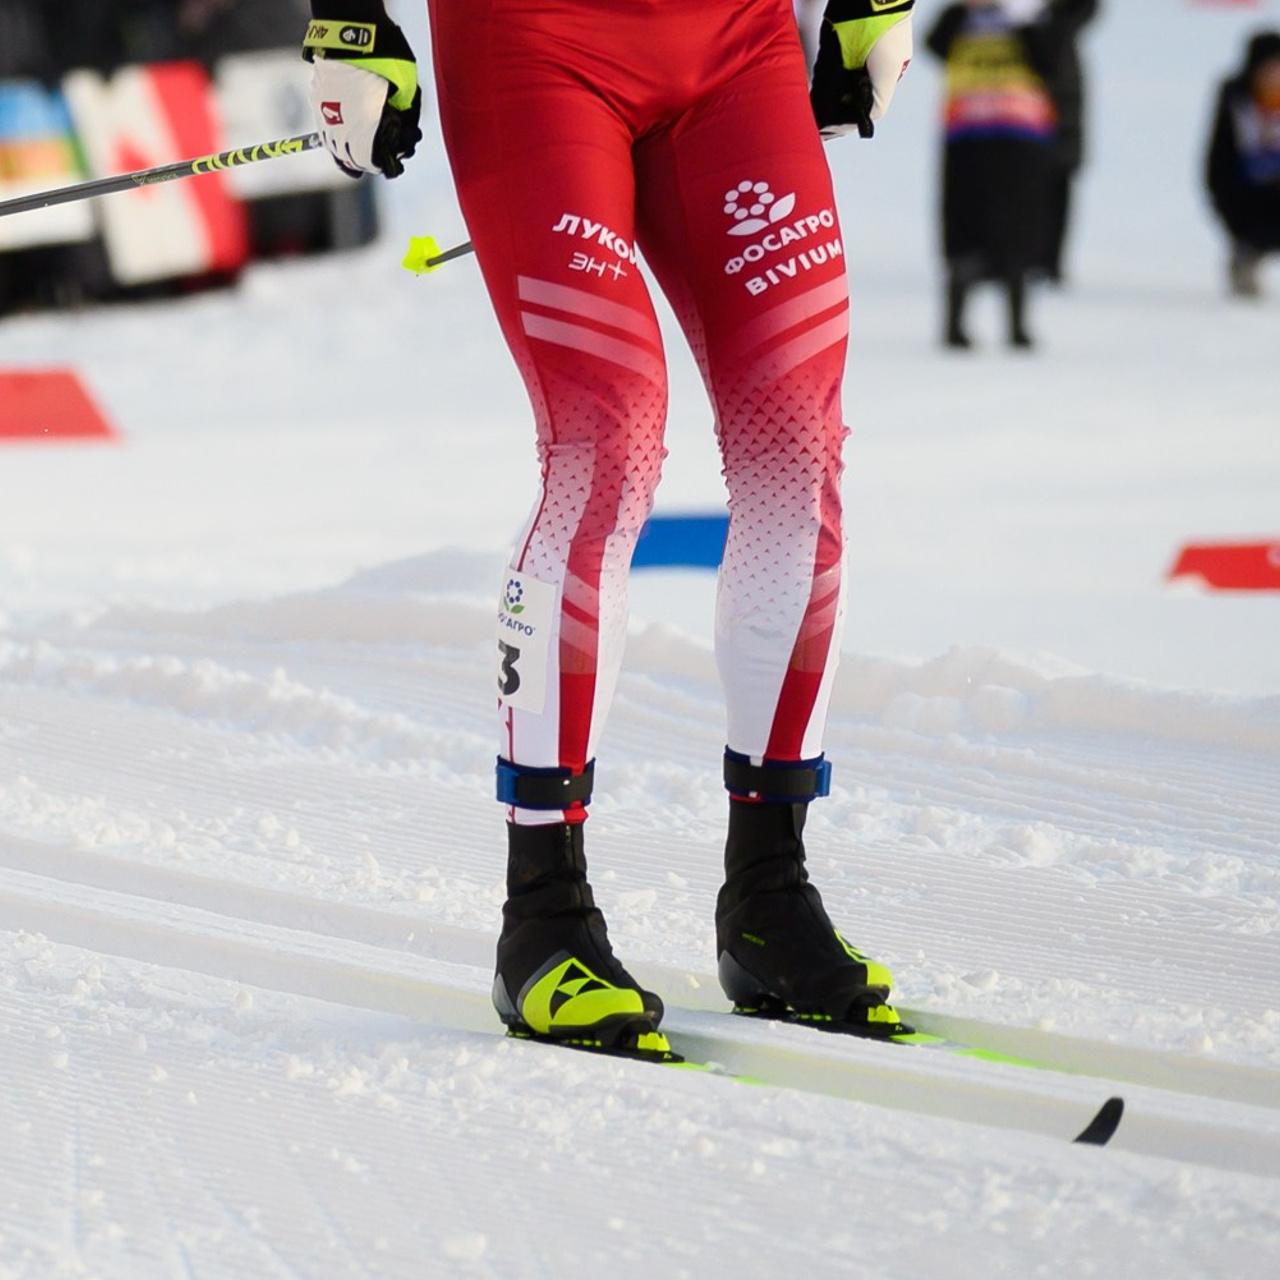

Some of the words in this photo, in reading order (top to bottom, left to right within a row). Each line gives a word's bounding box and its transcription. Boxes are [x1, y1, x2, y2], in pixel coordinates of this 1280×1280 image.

[724, 208, 834, 276] ФОСАГРО
[744, 238, 842, 297] BIVIUM
[498, 638, 520, 696] 3
